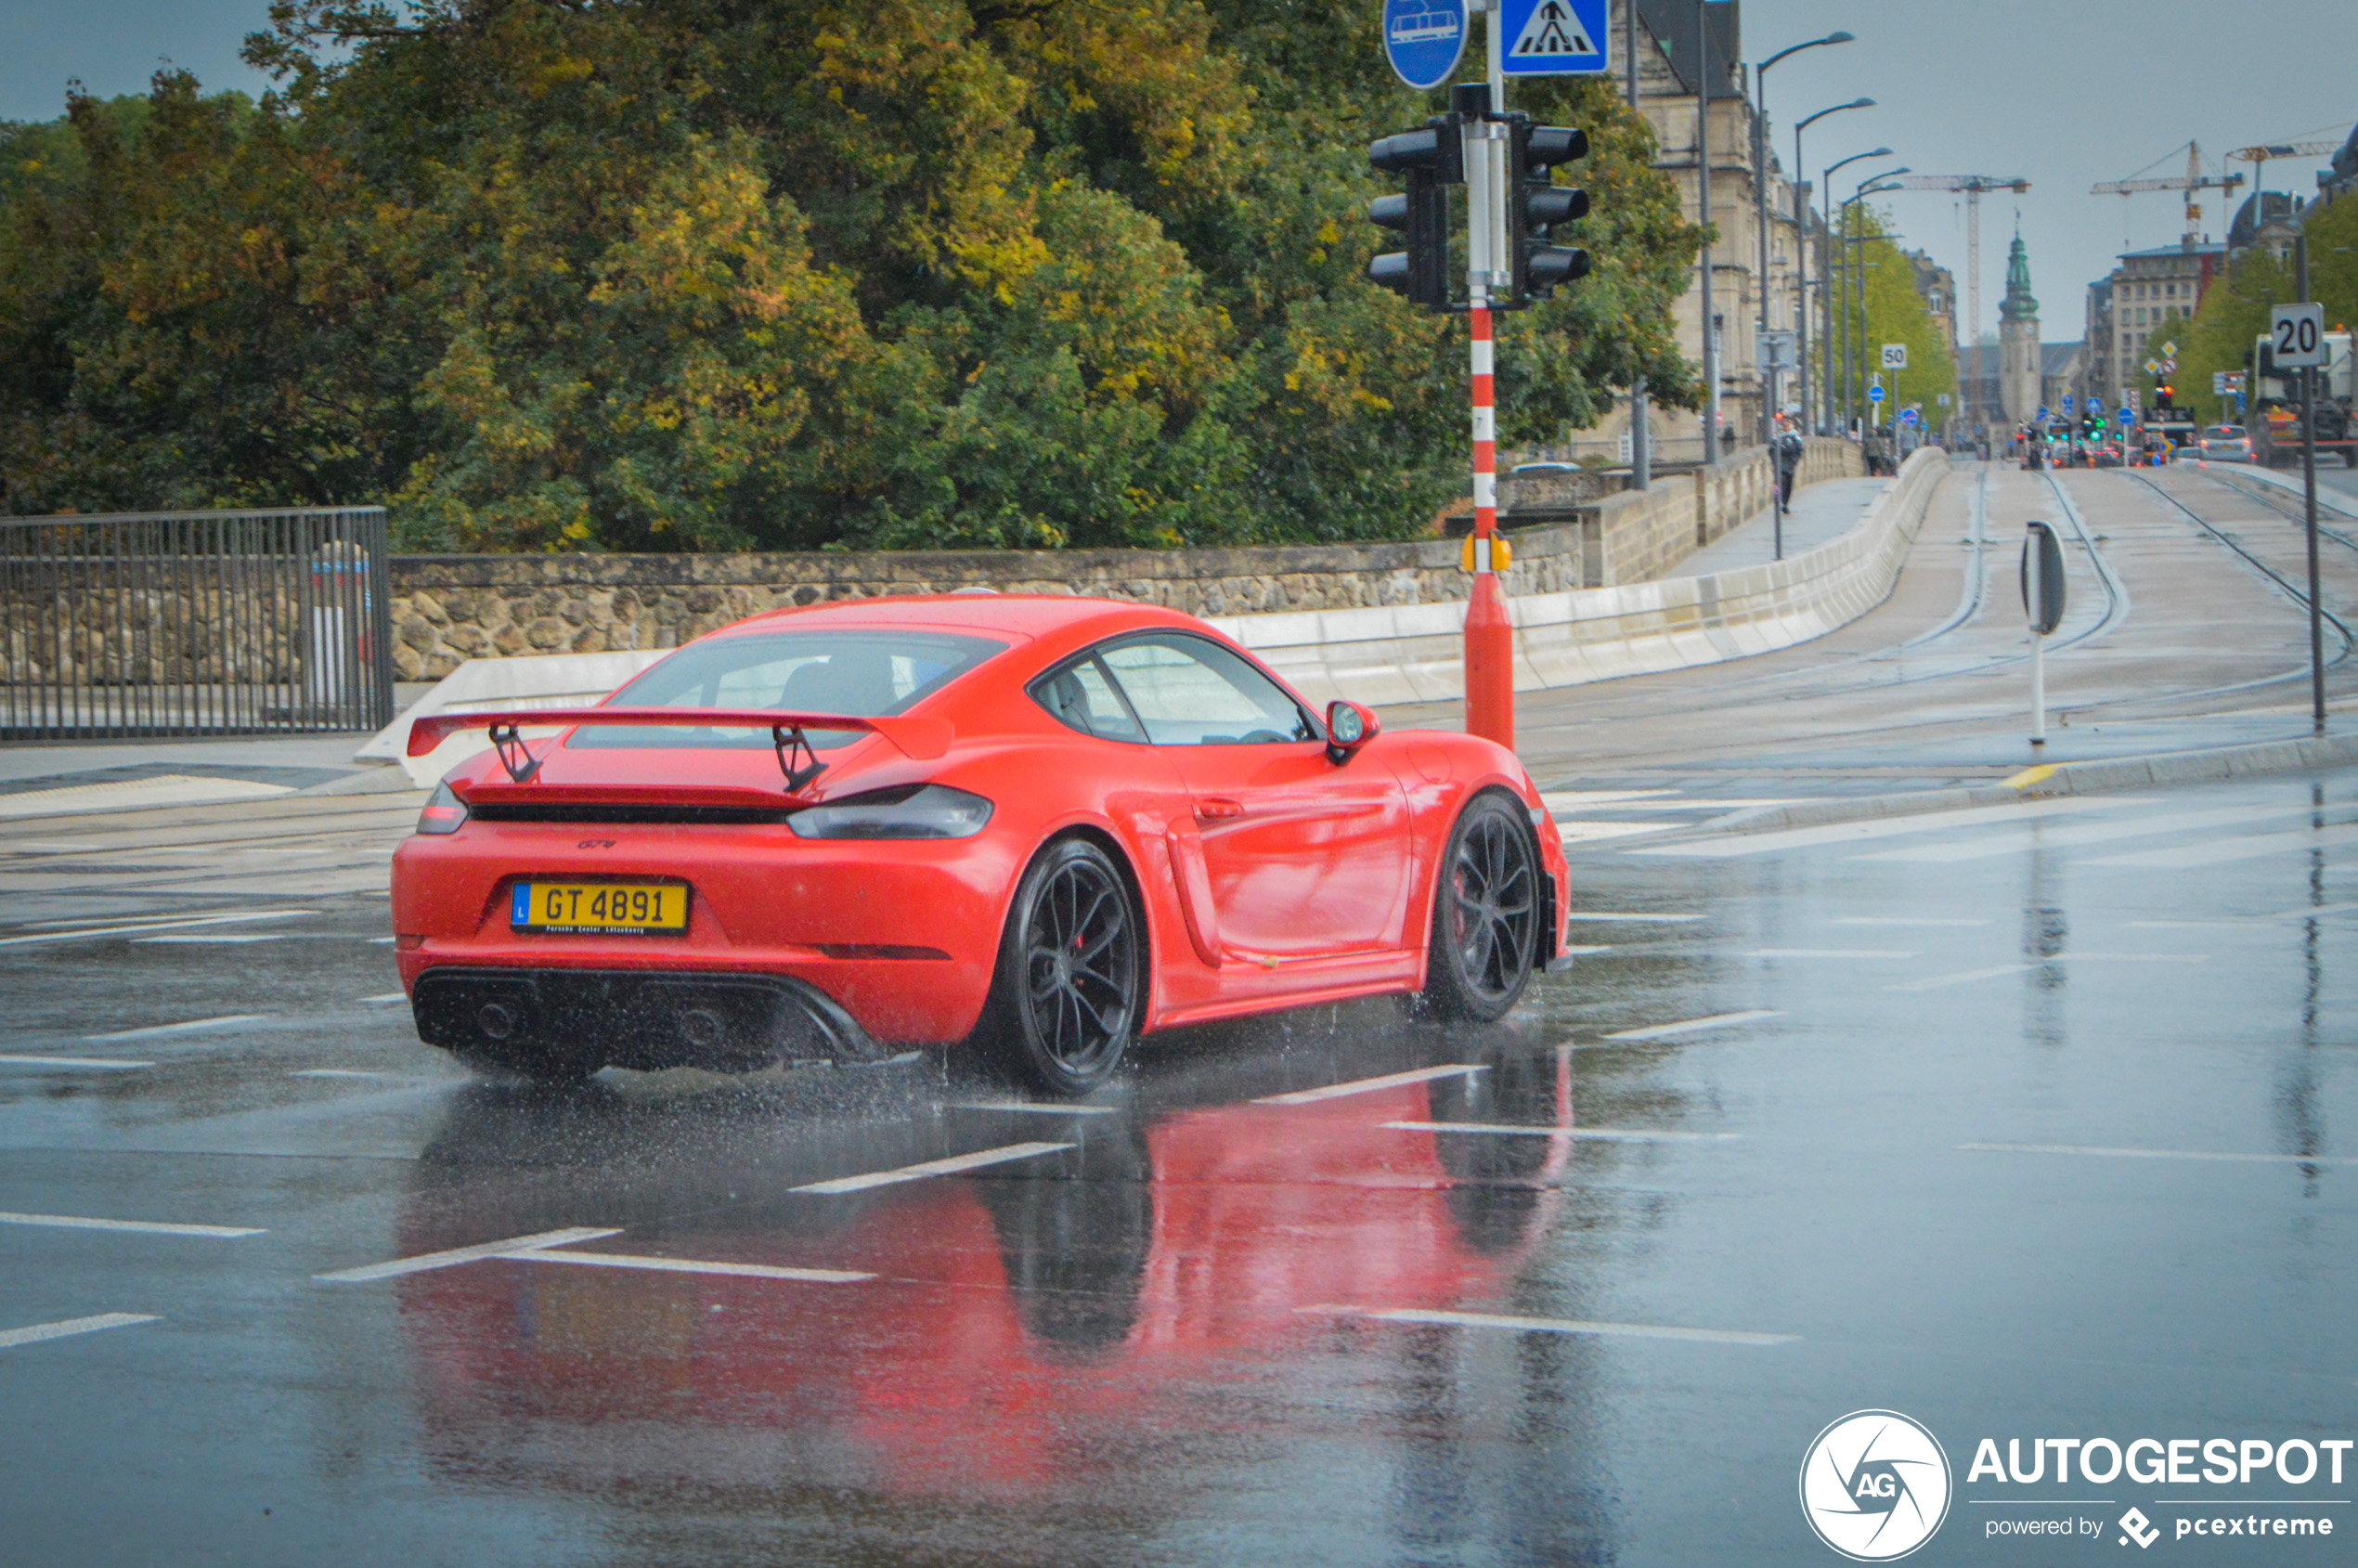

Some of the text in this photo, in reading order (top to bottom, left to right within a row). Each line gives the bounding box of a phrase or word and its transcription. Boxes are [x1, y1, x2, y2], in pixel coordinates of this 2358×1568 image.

[2276, 317, 2316, 354] 20
[1885, 349, 1903, 363] 50
[518, 906, 524, 918] L
[547, 888, 663, 922] GT 4891
